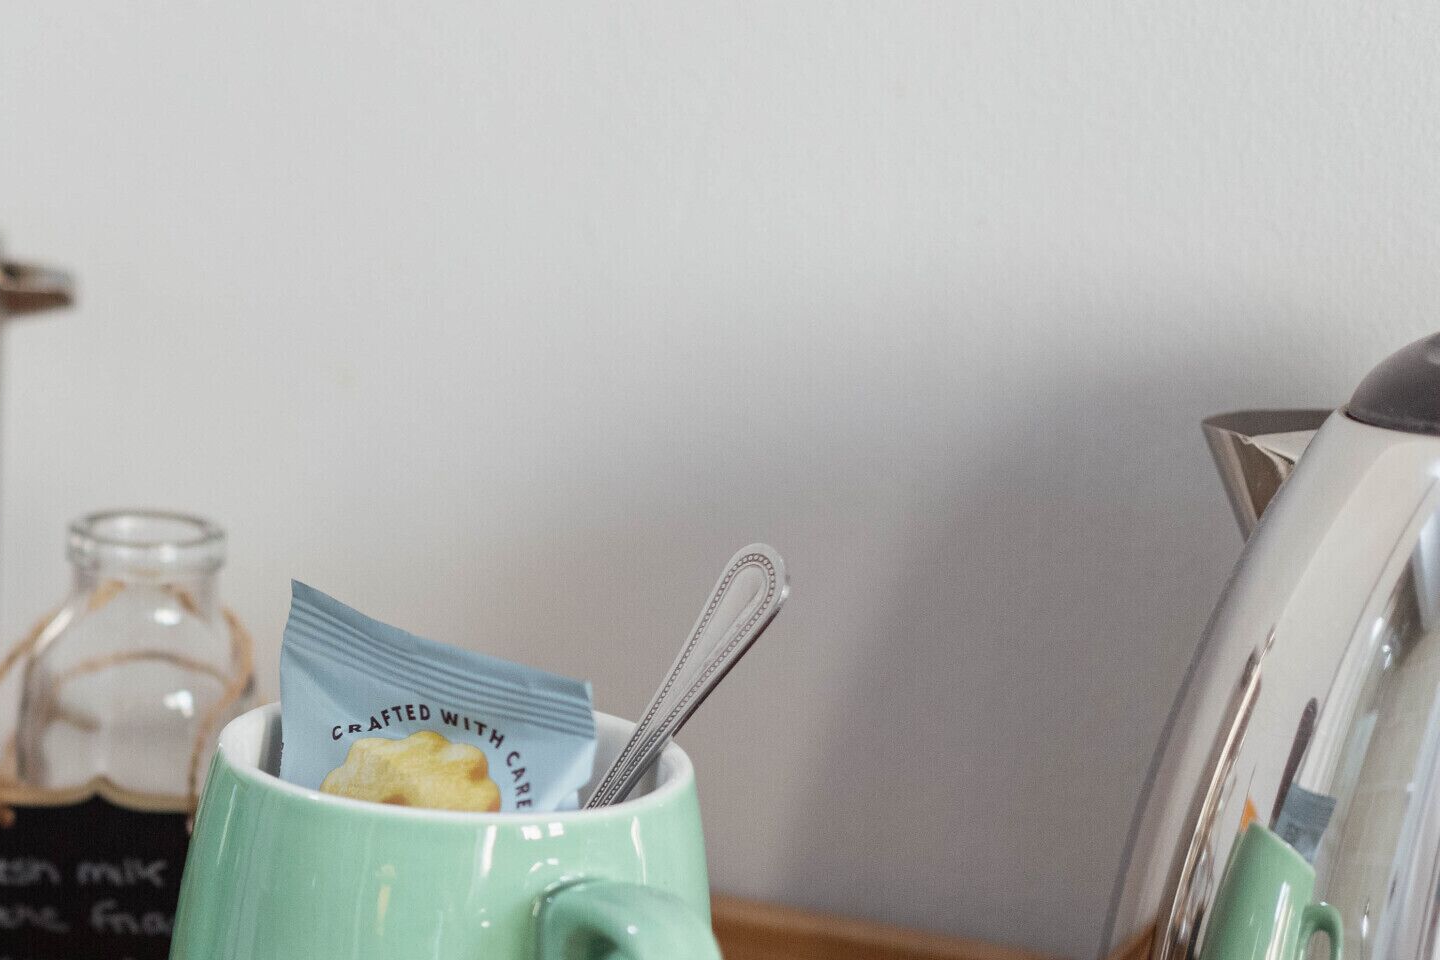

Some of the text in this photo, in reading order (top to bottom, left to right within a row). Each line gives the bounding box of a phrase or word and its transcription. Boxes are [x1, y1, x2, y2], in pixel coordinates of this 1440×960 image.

[331, 704, 533, 810] CRAFTED WITH CARE
